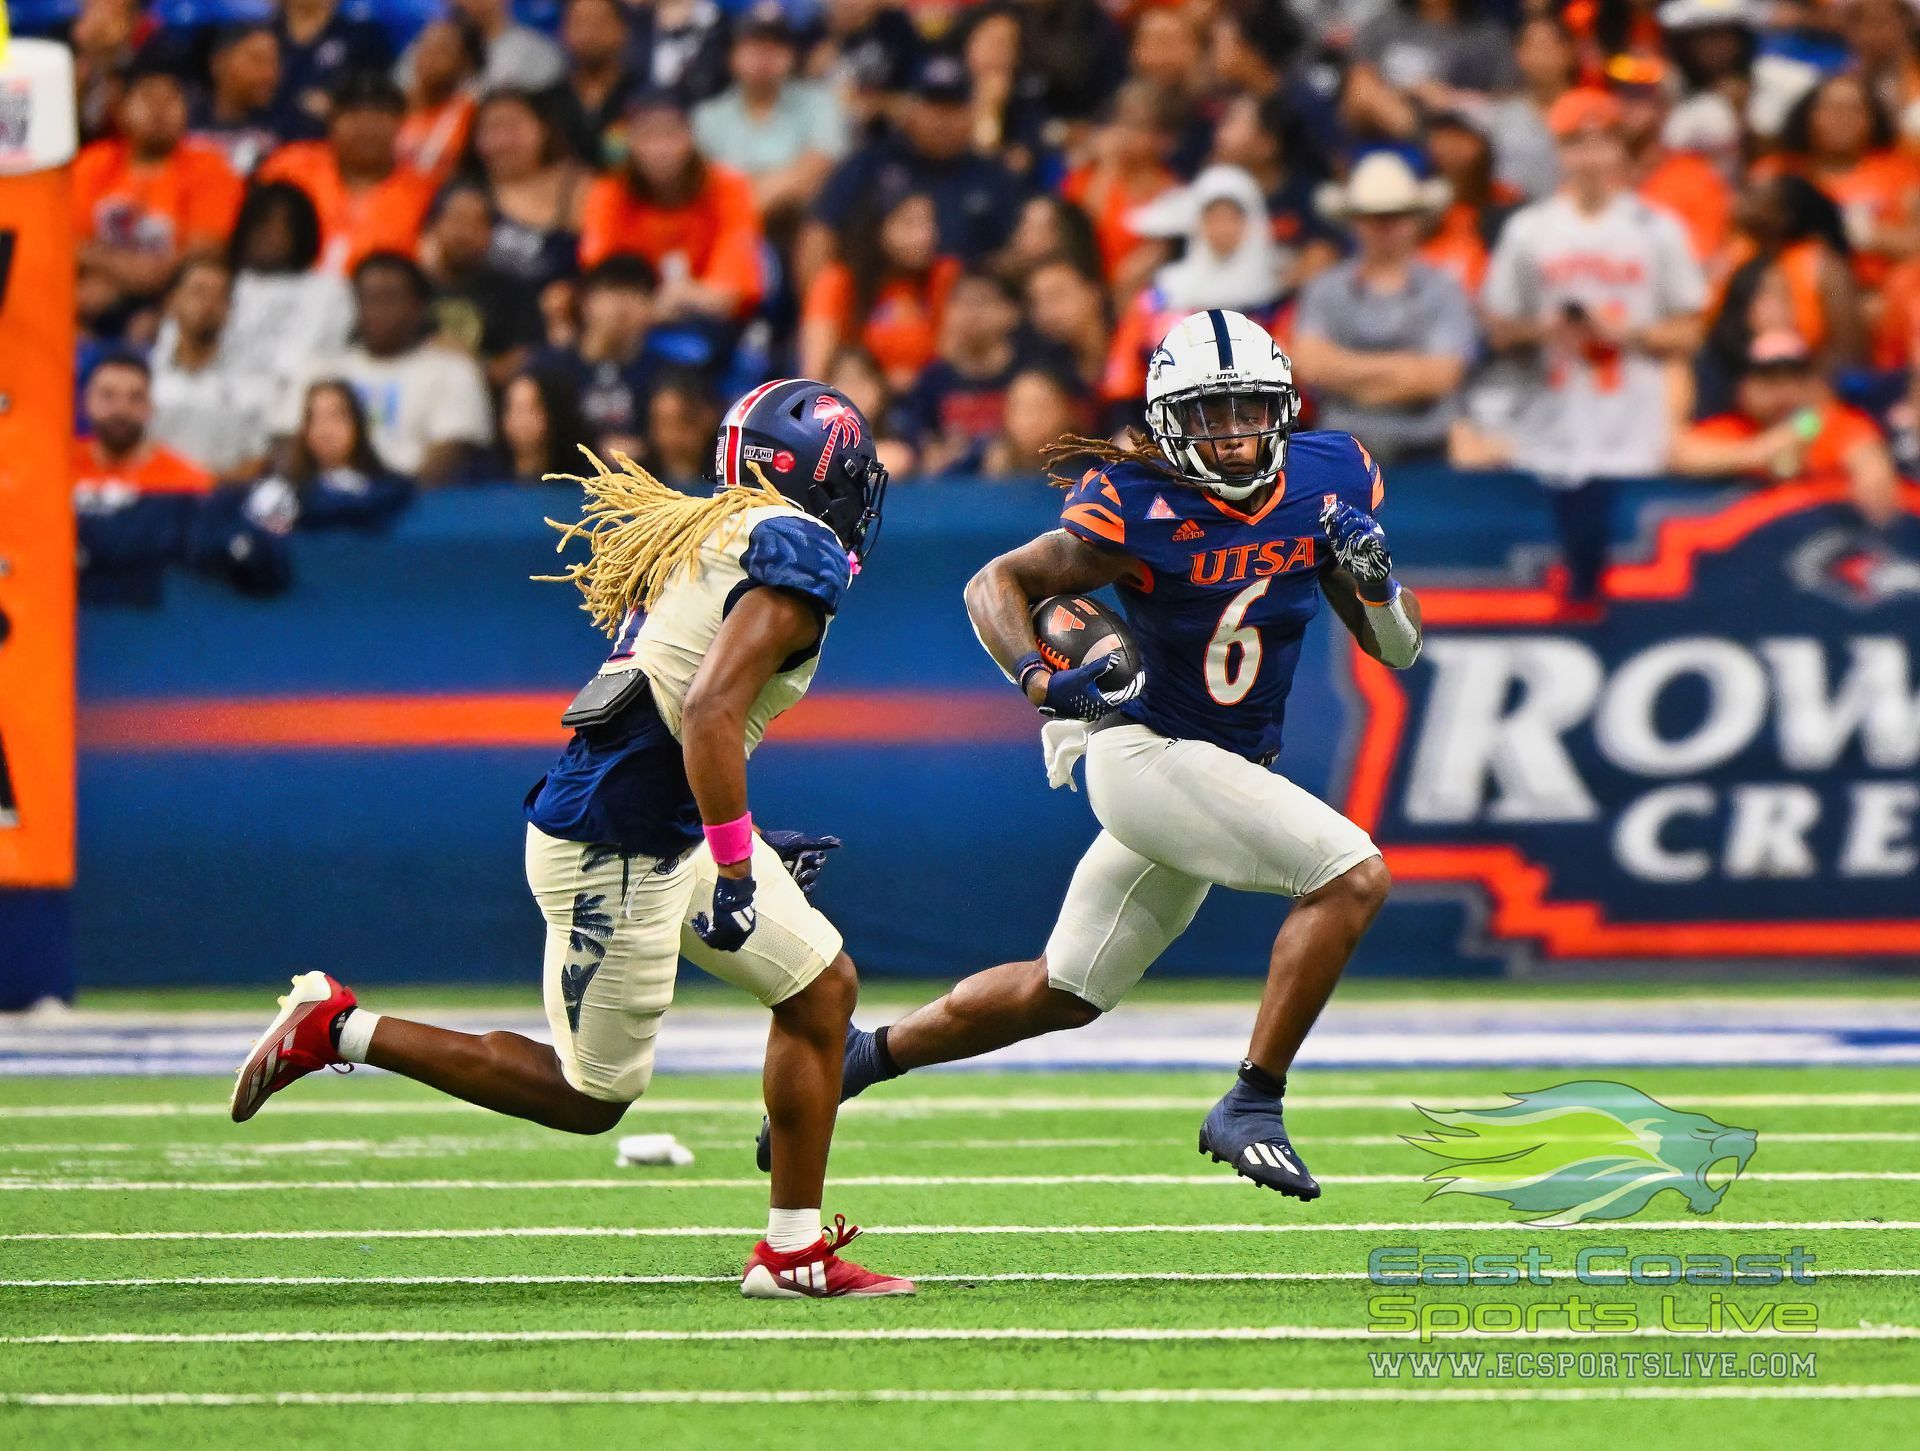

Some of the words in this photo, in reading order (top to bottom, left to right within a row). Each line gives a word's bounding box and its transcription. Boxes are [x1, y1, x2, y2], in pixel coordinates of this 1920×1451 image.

[1172, 530, 1205, 542] adidas
[1189, 536, 1315, 585] UTSA
[1203, 576, 1273, 706] 6
[1611, 782, 1920, 884] CRE
